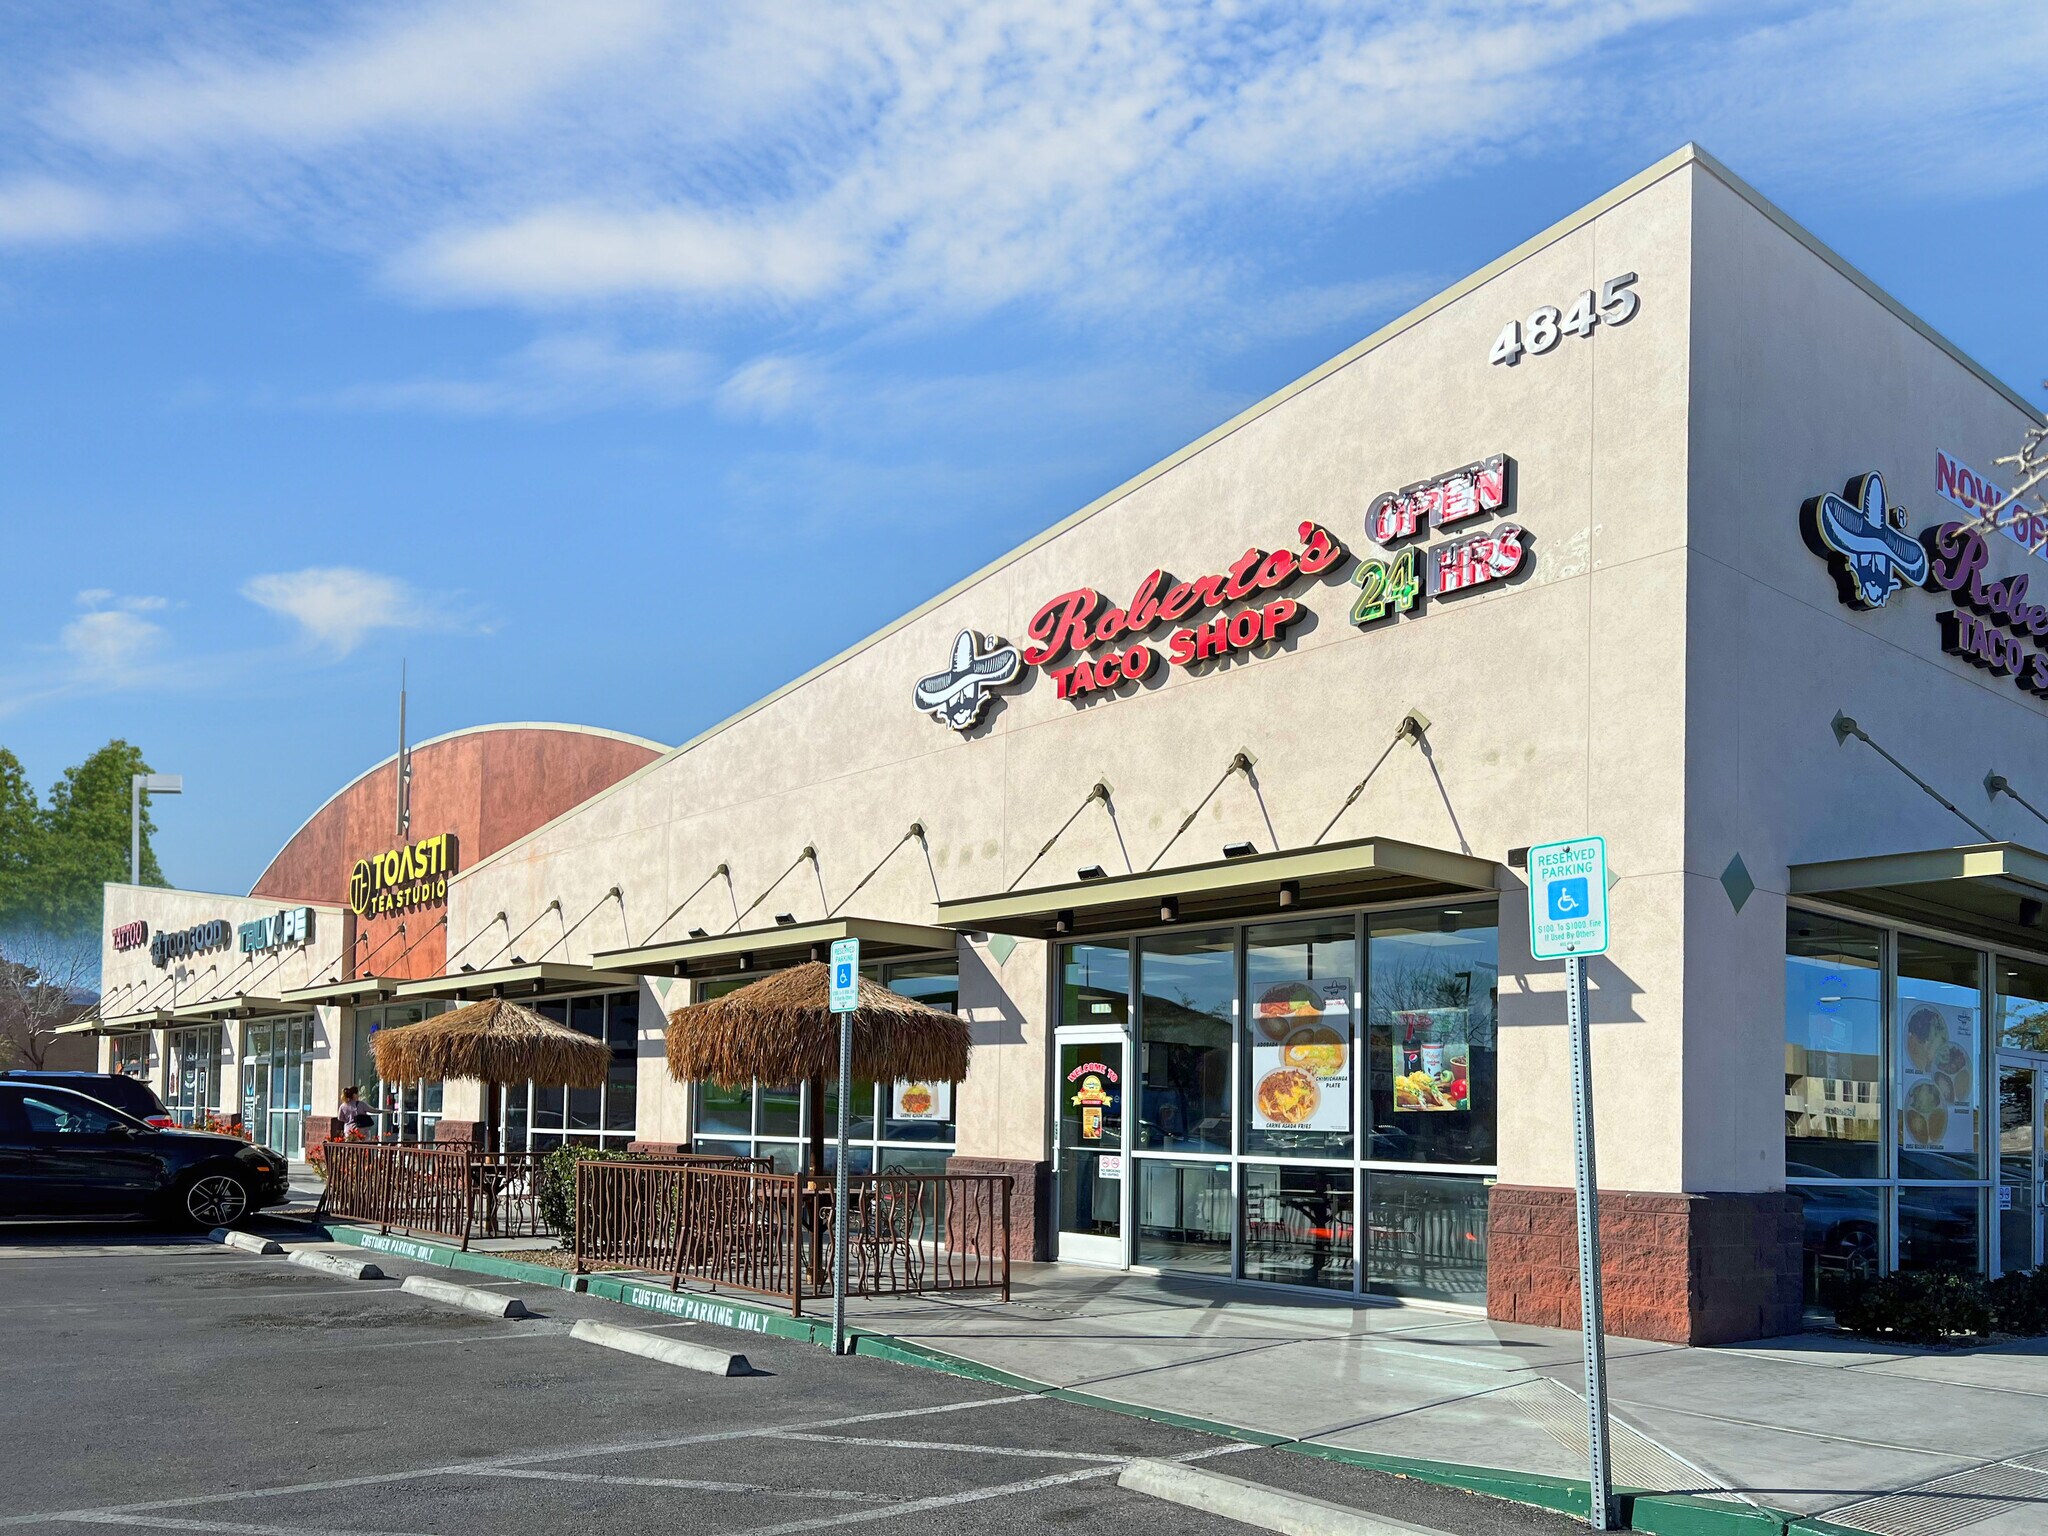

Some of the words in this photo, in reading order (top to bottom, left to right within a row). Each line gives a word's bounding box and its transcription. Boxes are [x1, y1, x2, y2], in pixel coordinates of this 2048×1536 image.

[1488, 271, 1639, 367] 4845
[1365, 453, 1510, 546] OPEN
[1937, 452, 2001, 526] NOW
[2012, 504, 2048, 558] OP
[1023, 519, 1340, 665] Roberto's
[1350, 546, 1418, 626] 24
[1427, 522, 1526, 597] HRS
[1050, 644, 1152, 699] TACO
[1168, 598, 1298, 666] SHOP
[1954, 609, 2024, 676] TACO
[373, 833, 447, 890] TOASTI
[1538, 848, 1596, 867] RESERVED
[1542, 861, 1593, 879] PARKING
[371, 894, 394, 914] TEA
[396, 879, 446, 908] STUDIO
[112, 920, 143, 950] TATTOO
[188, 919, 222, 953] GOOD
[1551, 932, 1564, 941] Used
[1566, 931, 1575, 940] By
[1576, 929, 1595, 939] Others
[1589, 919, 1602, 928] Fine
[1067, 1062, 1107, 1083] WELCOME
[1107, 1067, 1119, 1083] TO
[361, 1234, 391, 1251] CUSTOMER
[390, 1240, 417, 1256] PARKING
[417, 1246, 435, 1261] ONLY
[632, 1288, 683, 1314] CUSTOMER
[685, 1300, 733, 1327] PARKING
[738, 1311, 770, 1334] ONLY
